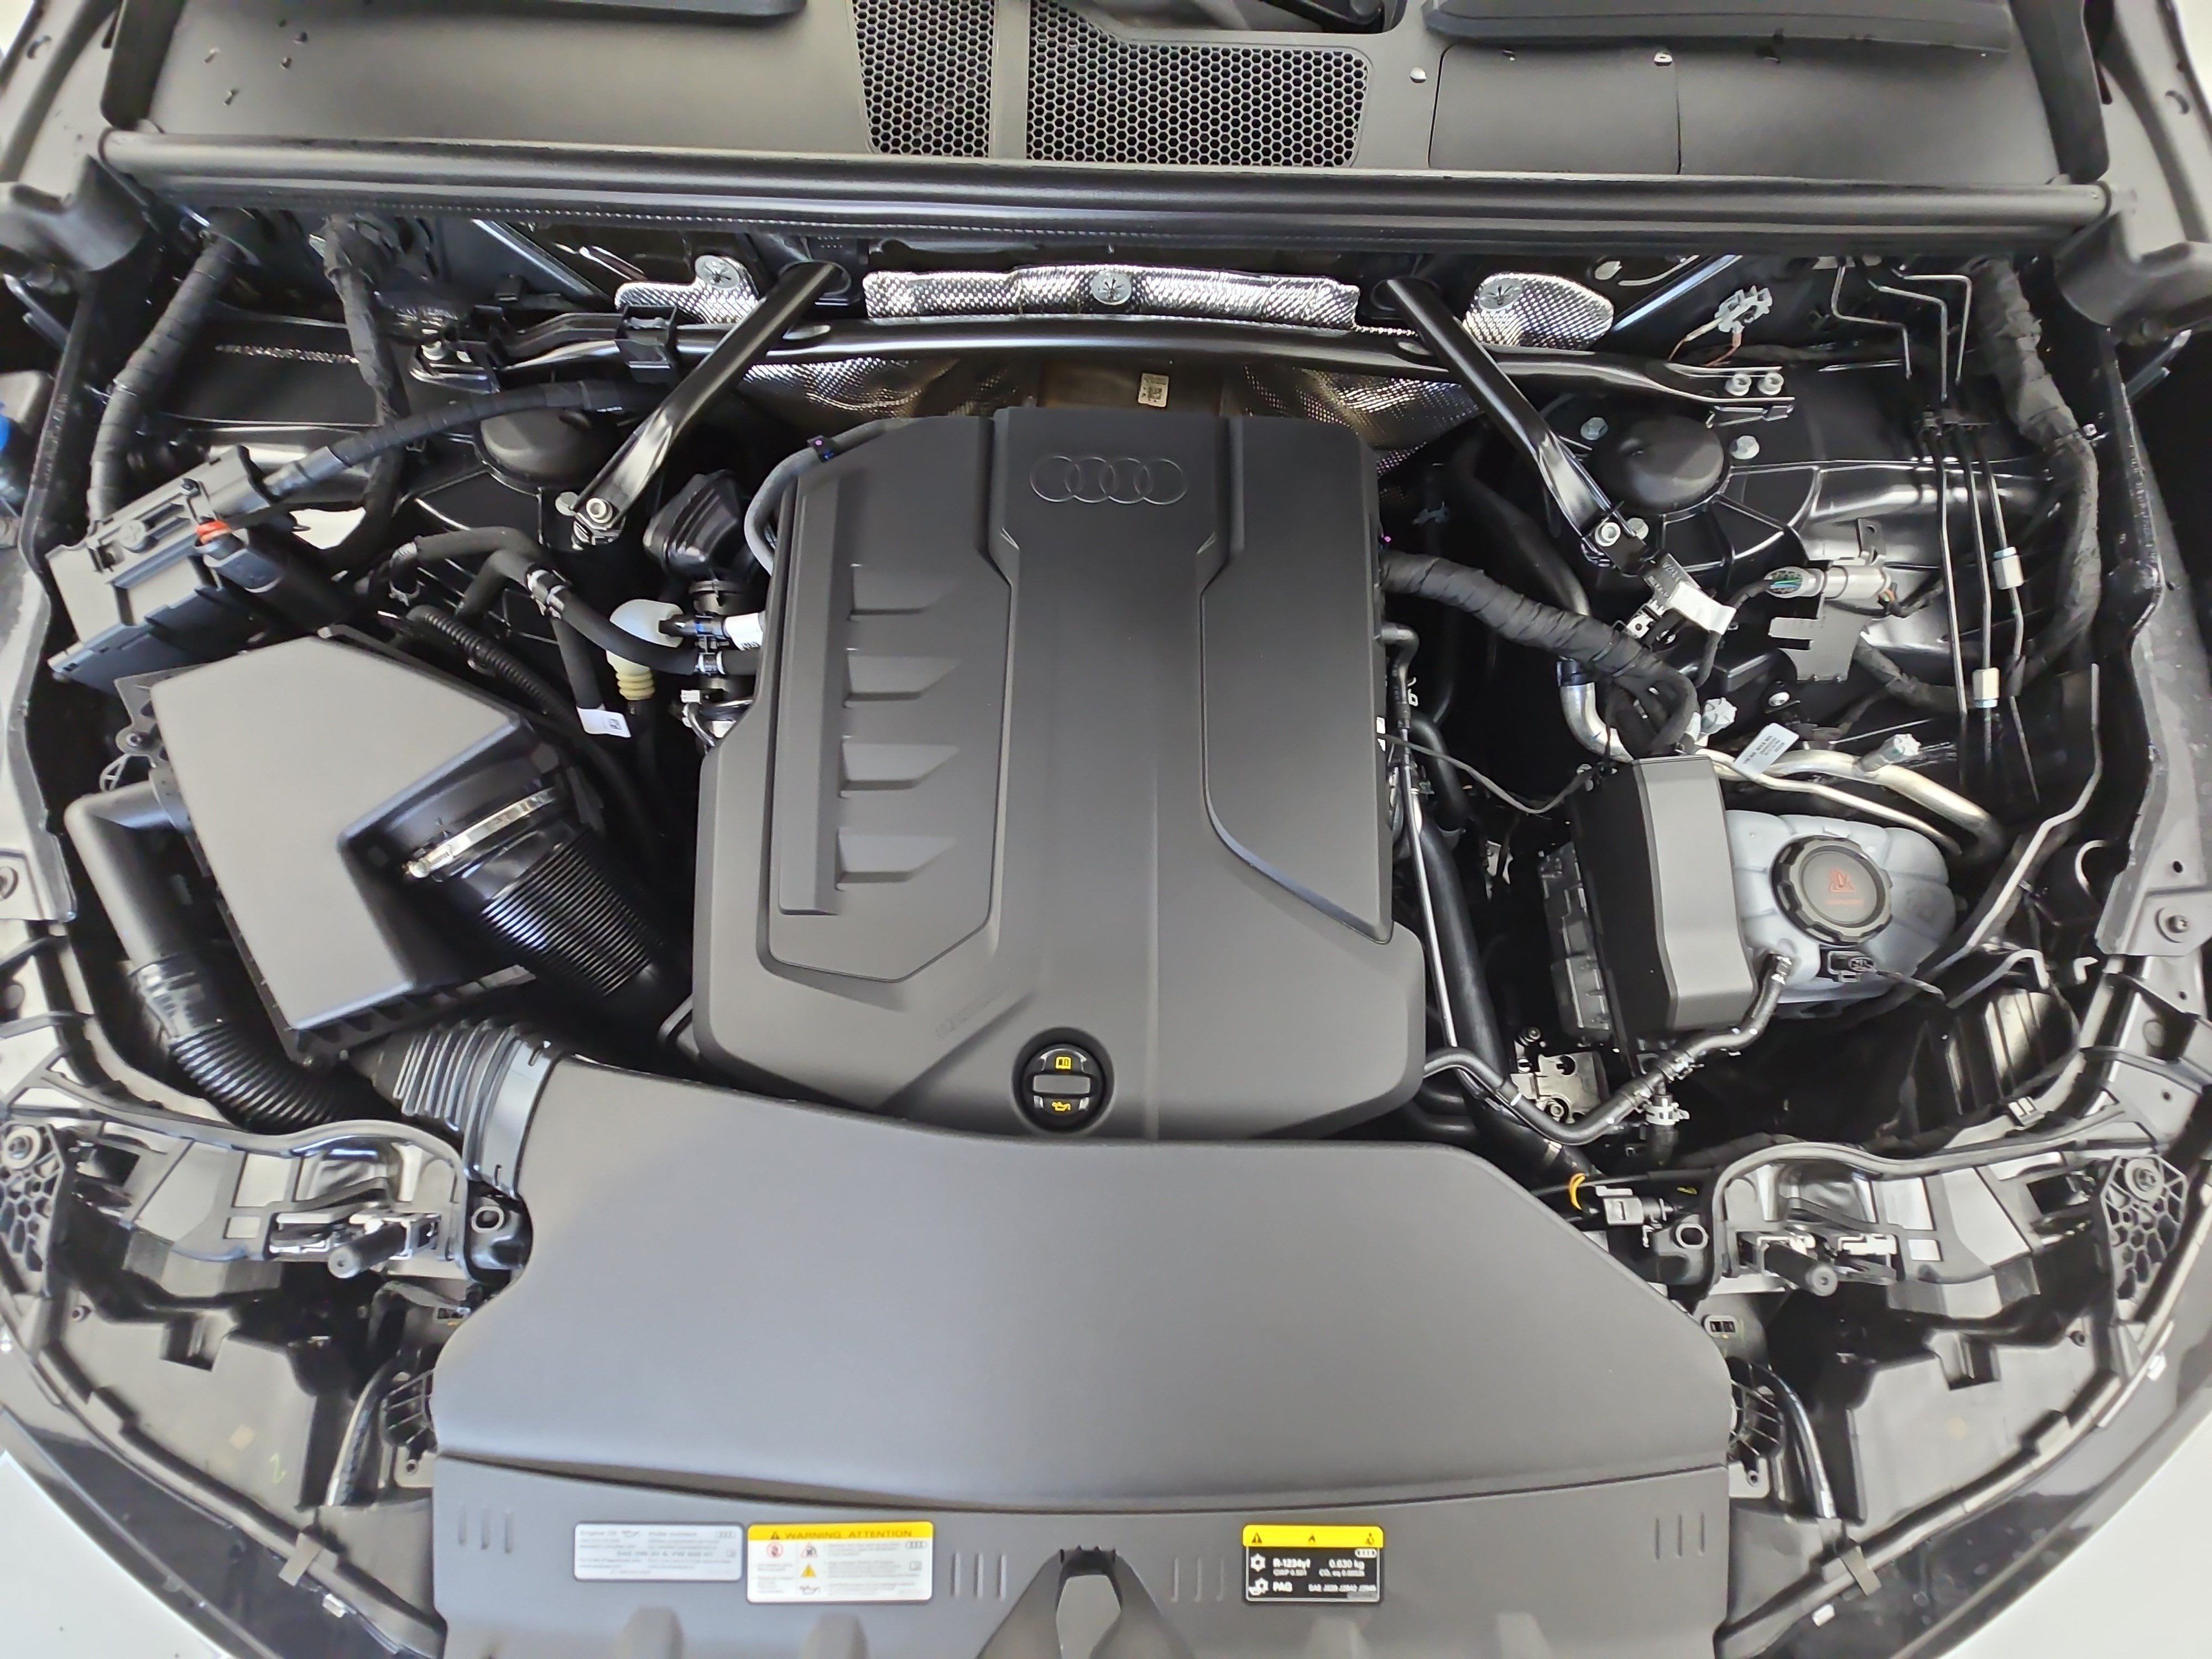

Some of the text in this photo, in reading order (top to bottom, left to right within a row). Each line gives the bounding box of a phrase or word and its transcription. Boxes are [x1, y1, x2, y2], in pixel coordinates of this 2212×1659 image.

[848, 1530, 912, 1538] ATTENTION
[1273, 1558, 1311, 1569] R-1234yf
[1273, 1582, 1293, 1593] PAG
